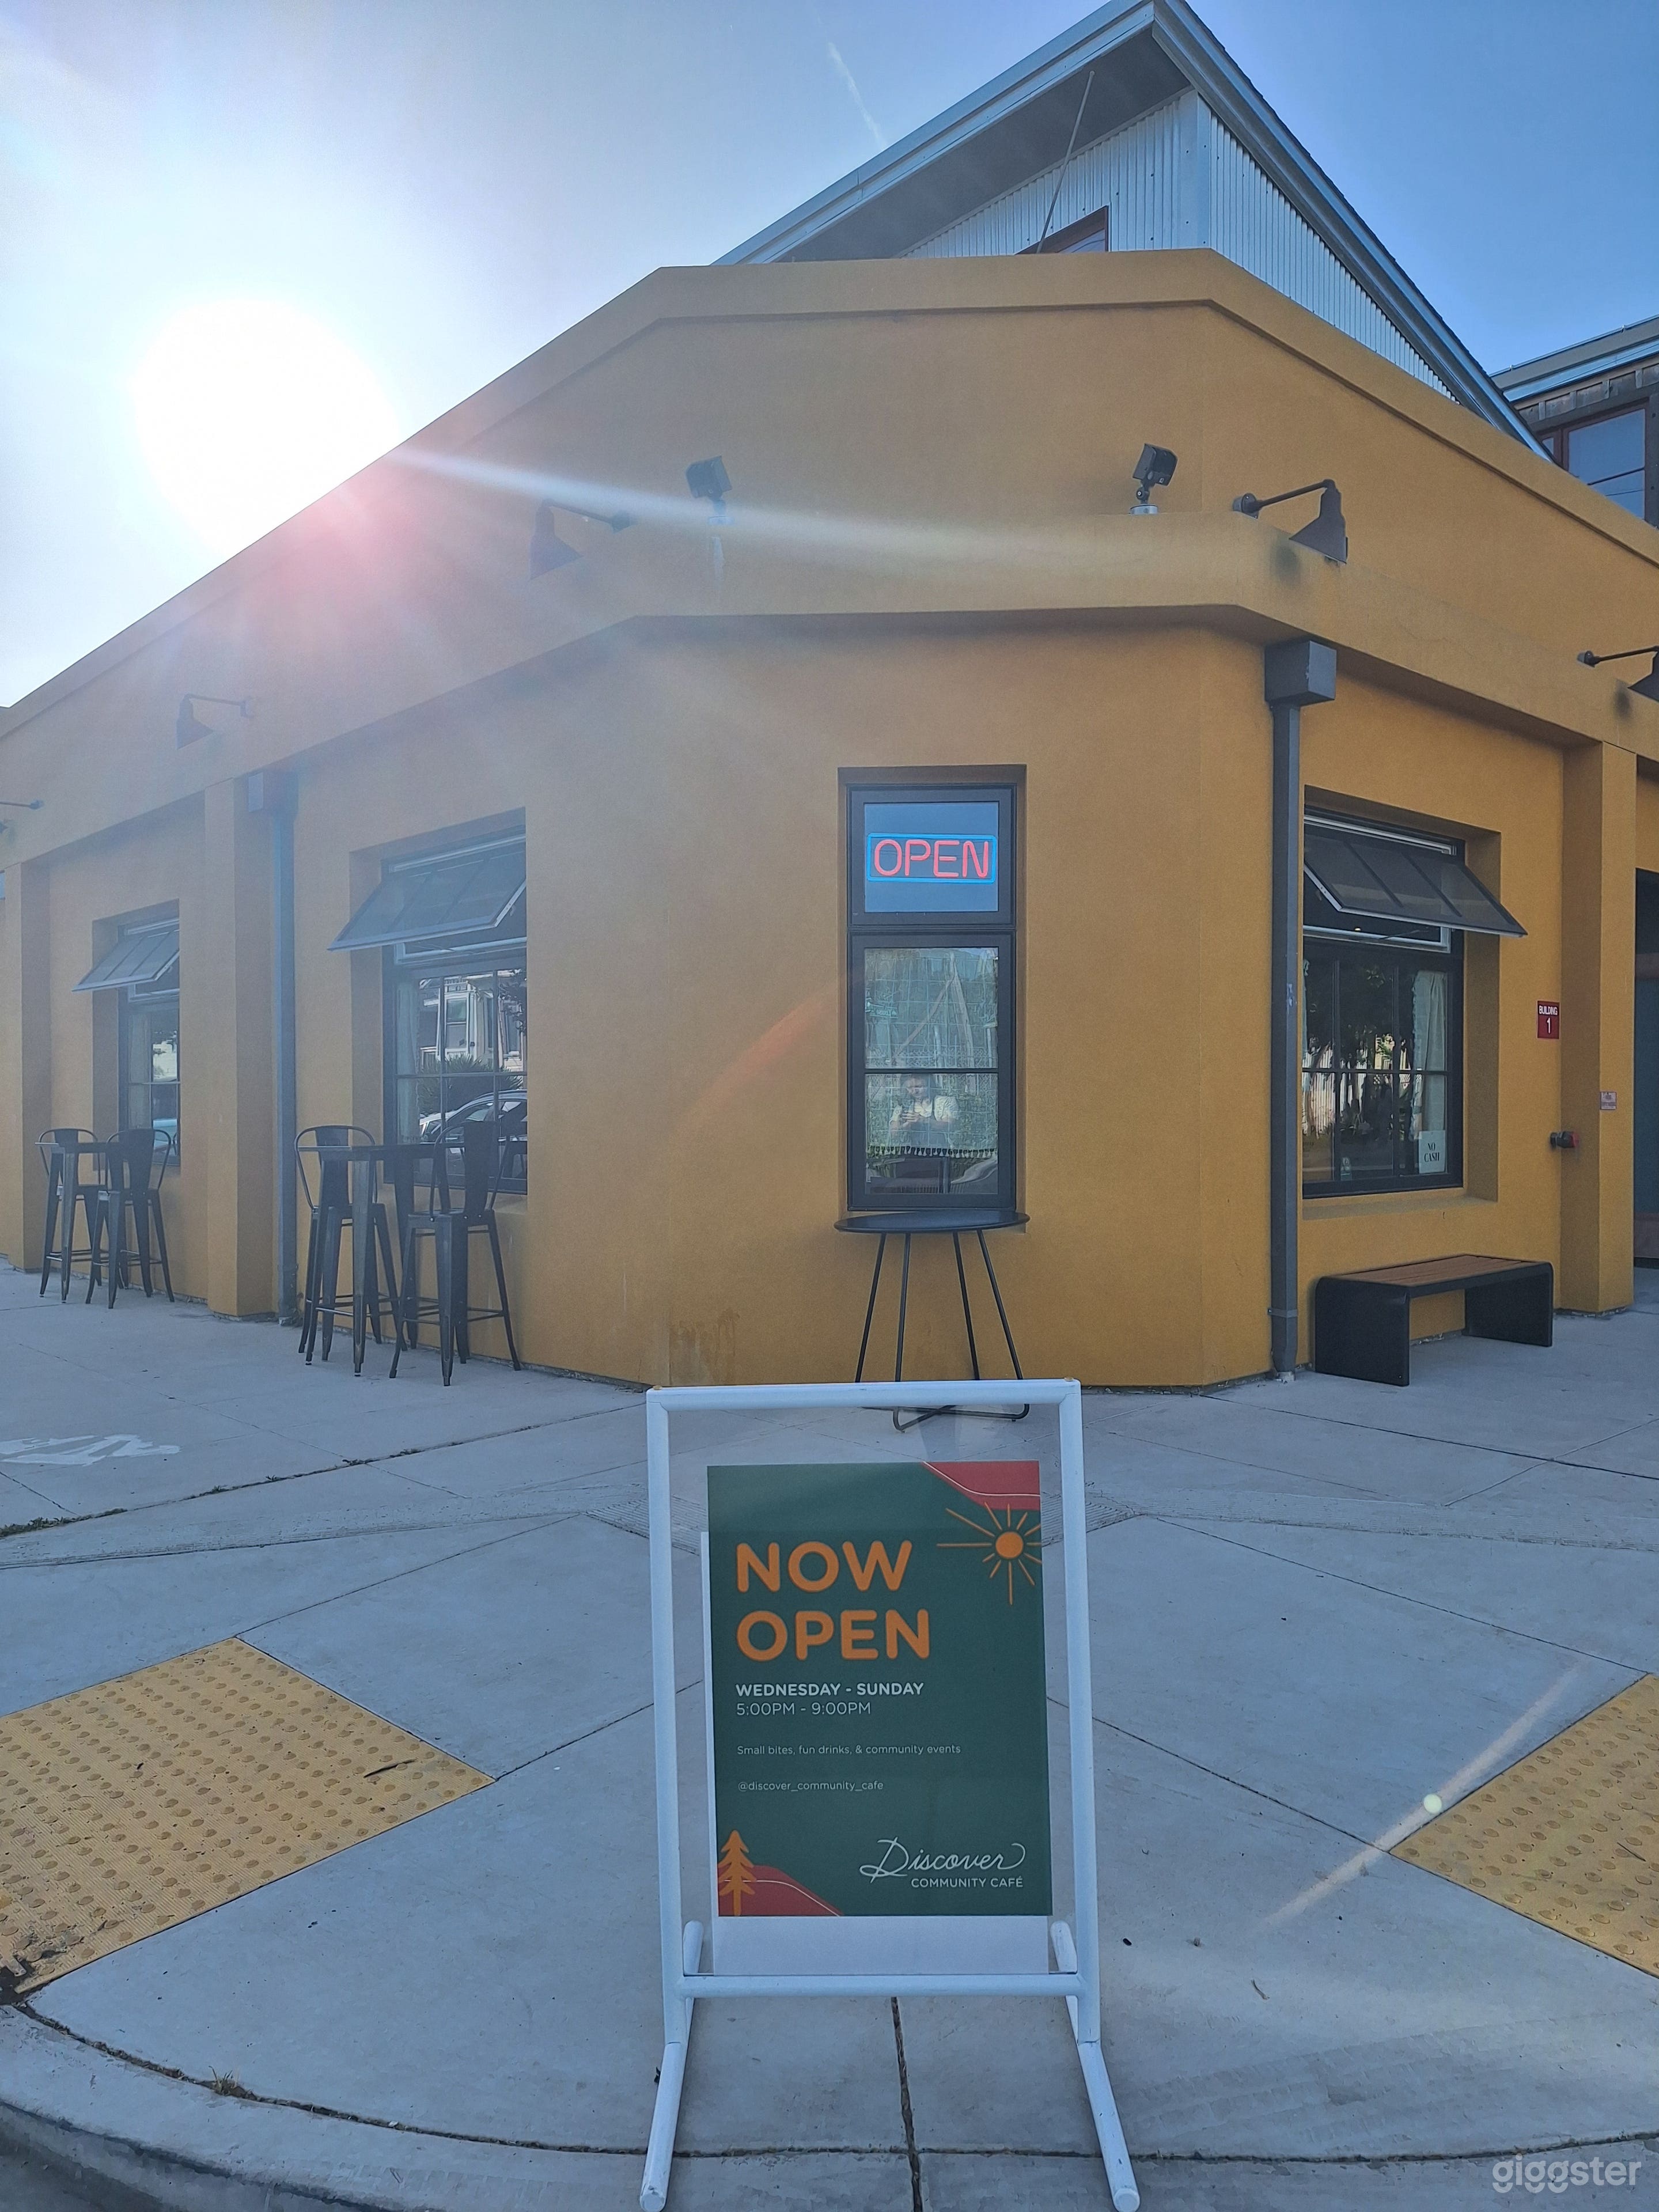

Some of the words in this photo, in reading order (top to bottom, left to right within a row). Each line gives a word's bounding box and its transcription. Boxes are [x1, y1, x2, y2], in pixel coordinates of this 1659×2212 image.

[873, 839, 990, 878] OPEN
[1539, 1005, 1558, 1016] BUILDING
[1546, 1017, 1551, 1034] 1
[1427, 1142, 1436, 1152] NO
[1424, 1152, 1440, 1162] CASH
[736, 1540, 913, 1593] NOW
[736, 1609, 930, 1662] OPEN
[736, 1683, 841, 1696] WEDNESDAY
[857, 1682, 924, 1696] SUNDAY
[736, 1702, 796, 1716] 5:00PM
[811, 1702, 872, 1715] 9:00PM
[737, 1745, 765, 1755] Small
[768, 1745, 796, 1756] bites,
[798, 1745, 816, 1755] fun
[818, 1745, 852, 1755] drinks,
[855, 1744, 862, 1754] &
[865, 1744, 924, 1755] community
[927, 1744, 961, 1754] events
[738, 1780, 884, 1792] @discover_community_cafe
[859, 1836, 1026, 1884] Discover
[911, 1877, 987, 1888] COMMUNITY
[990, 1876, 1024, 1888] CAFÉ
